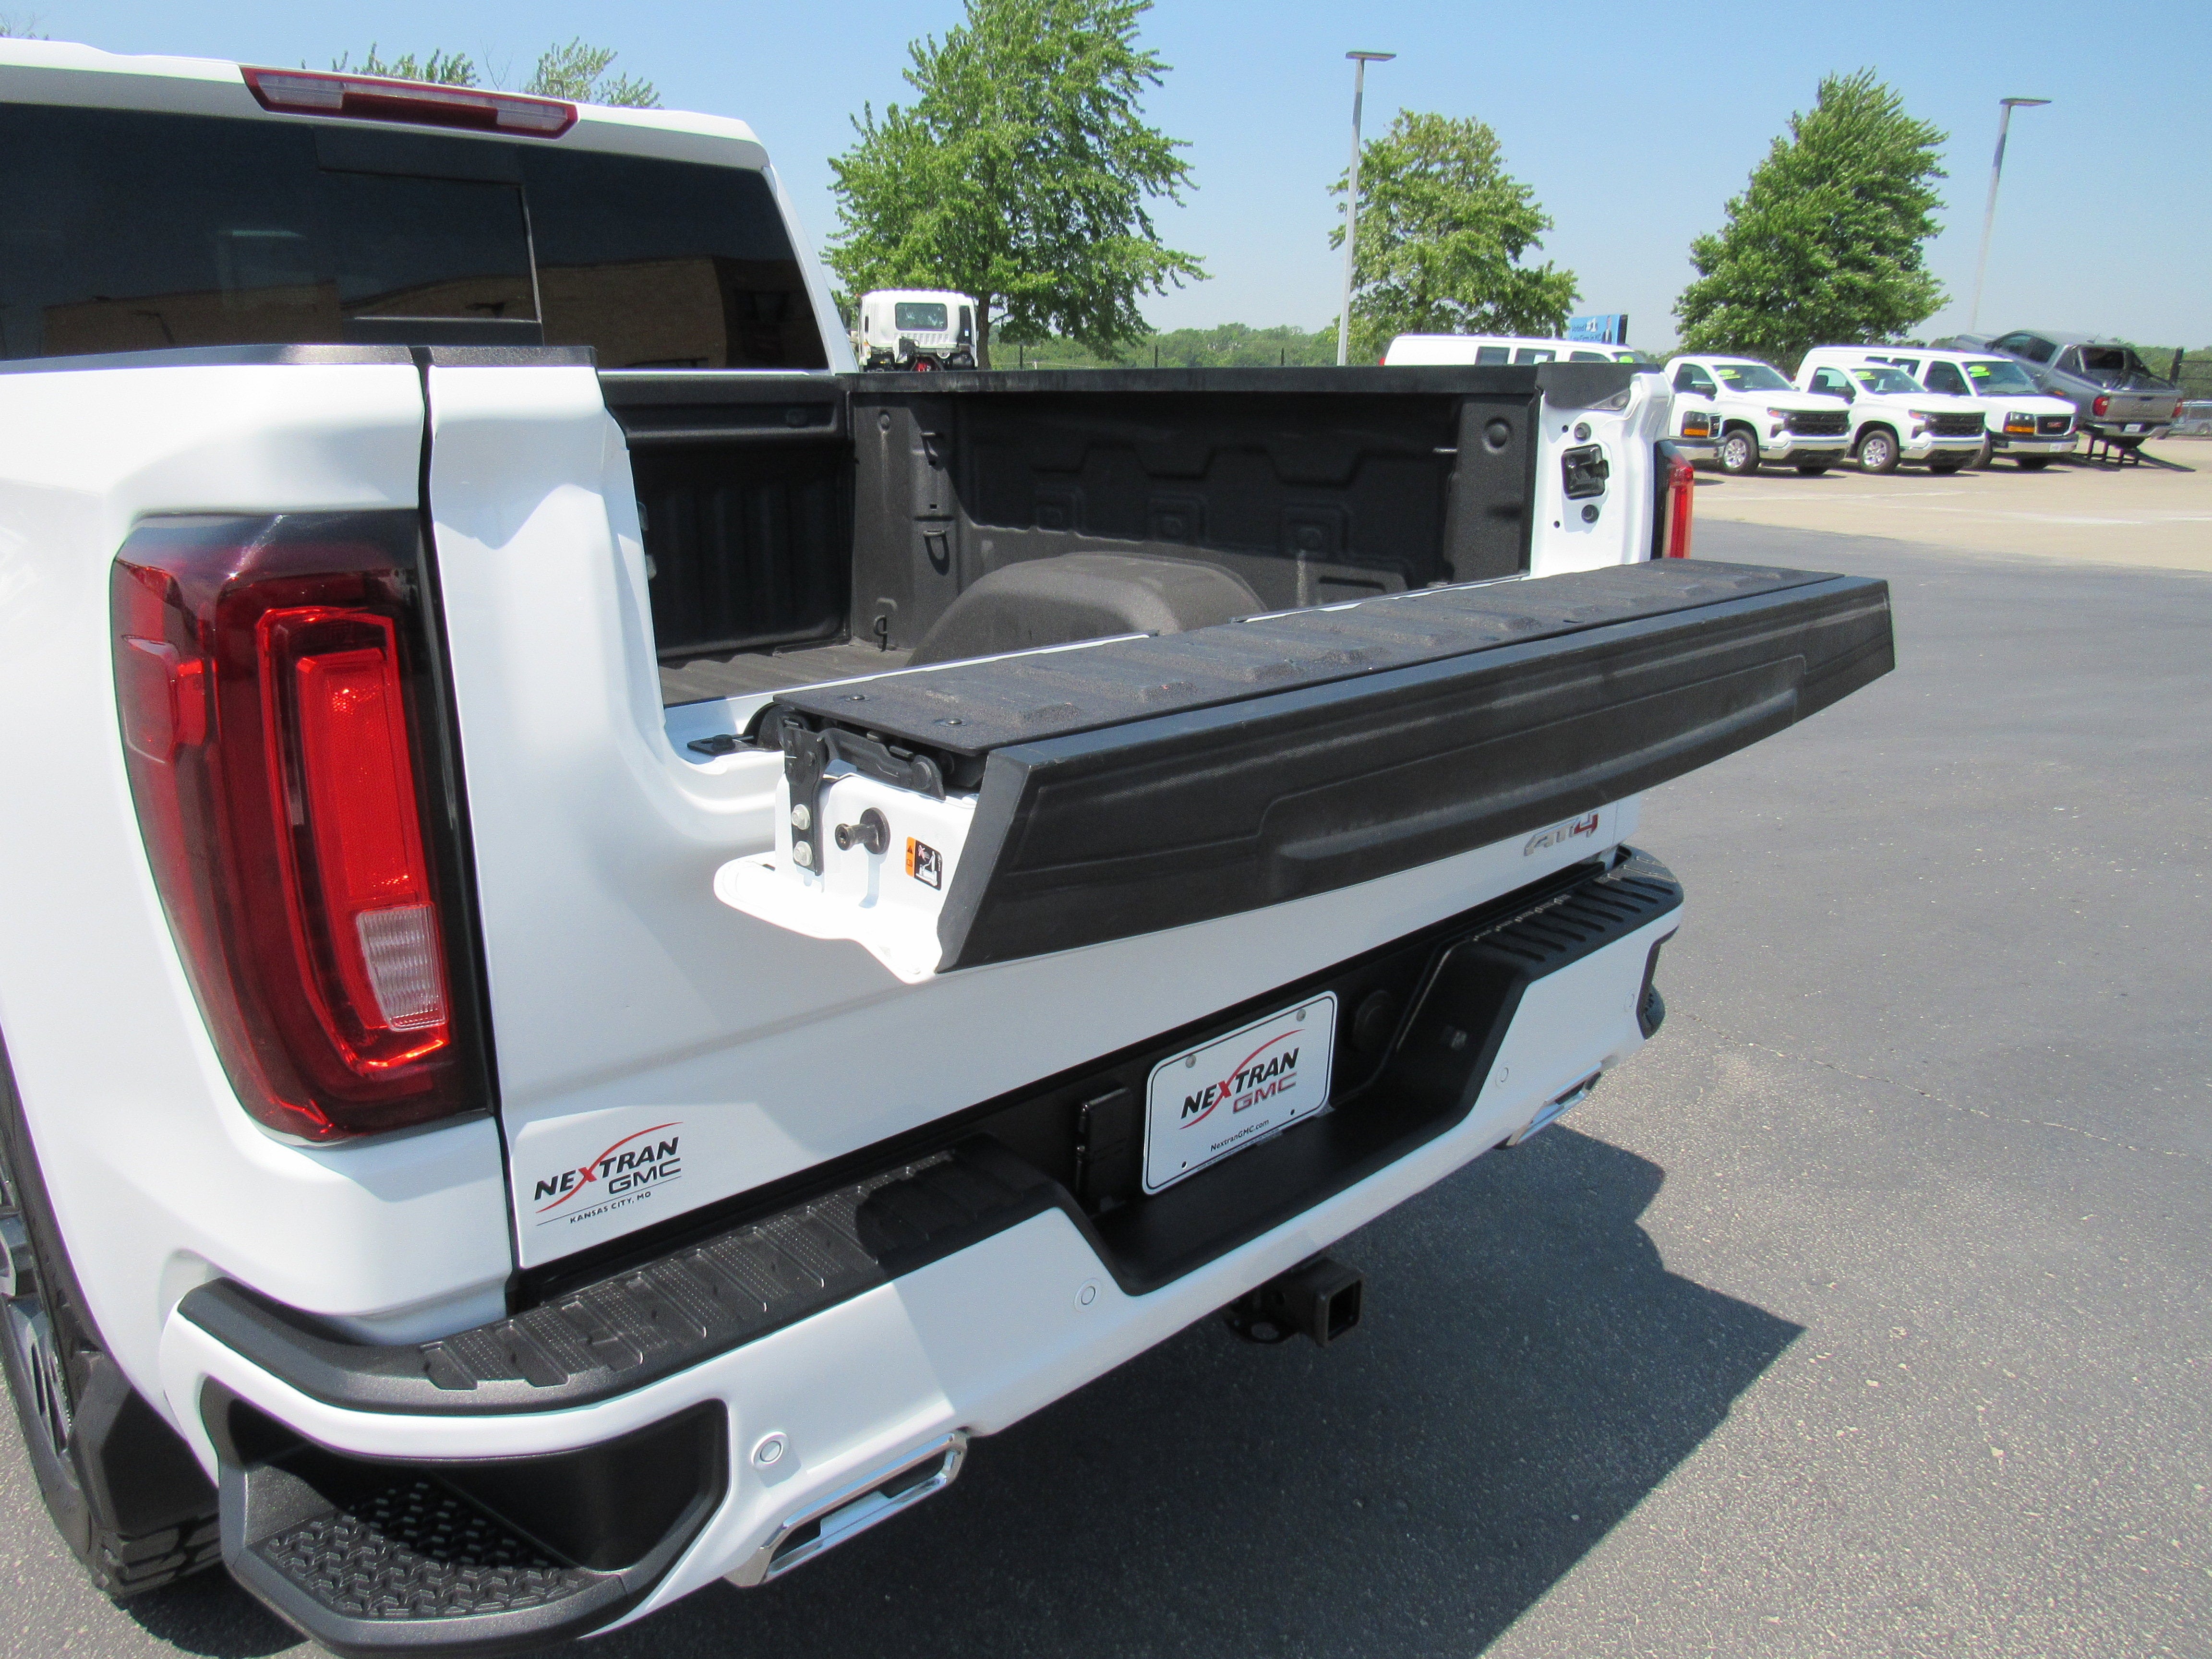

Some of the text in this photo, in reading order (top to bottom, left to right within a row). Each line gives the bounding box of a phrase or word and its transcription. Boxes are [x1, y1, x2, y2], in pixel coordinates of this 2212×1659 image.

[1524, 810, 1599, 856] AT4
[1181, 1047, 1299, 1119] NEXTRAN
[1233, 1072, 1297, 1114] GMC
[1210, 1119, 1269, 1152] NextranGMC.com
[534, 1137, 679, 1201] NEXTRAN
[609, 1157, 682, 1194] GMC
[570, 1191, 651, 1224] KANSAS CITY, MO
